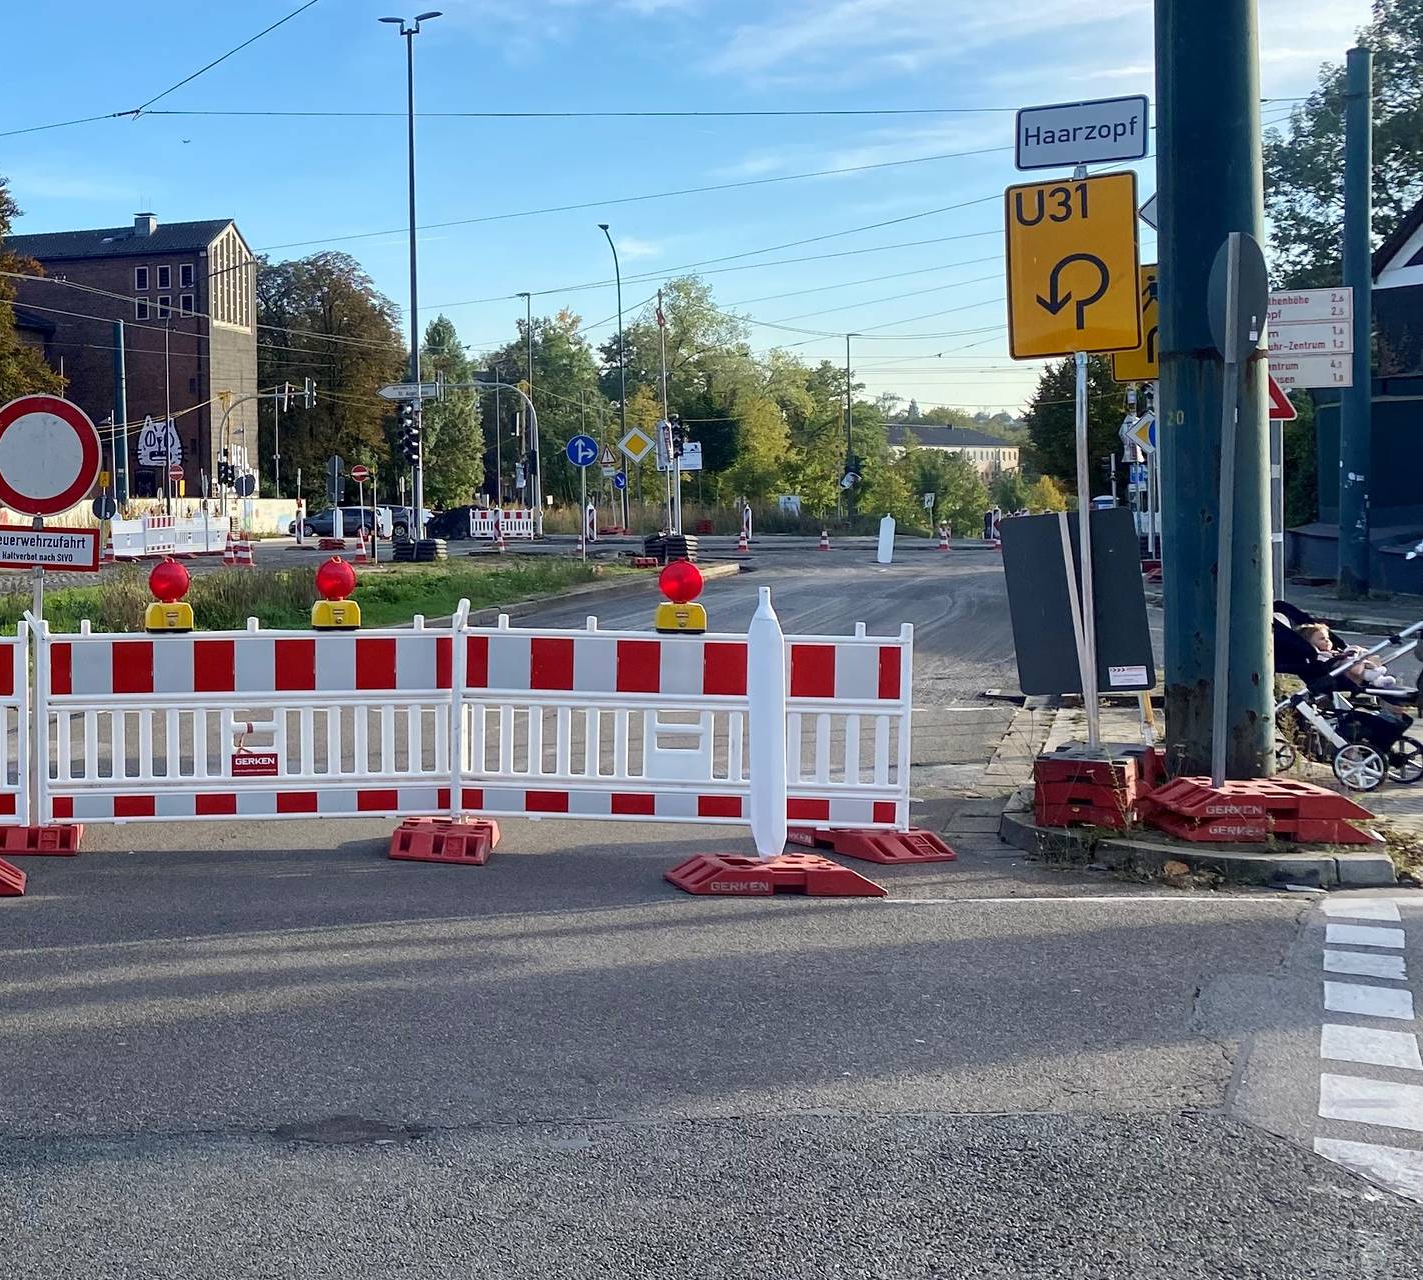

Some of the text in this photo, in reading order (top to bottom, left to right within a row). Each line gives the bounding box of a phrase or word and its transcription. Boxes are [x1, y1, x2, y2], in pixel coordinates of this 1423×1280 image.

[1024, 116, 1138, 146] Haarzopf
[1015, 183, 1089, 227] U31
[1266, 310, 1282, 321] opf
[1268, 341, 1326, 351] uhr-Zentrum
[2, 550, 73, 563] Haltverbot nach StVO
[235, 757, 275, 765] GERKEN
[710, 881, 770, 891] GERKEN
